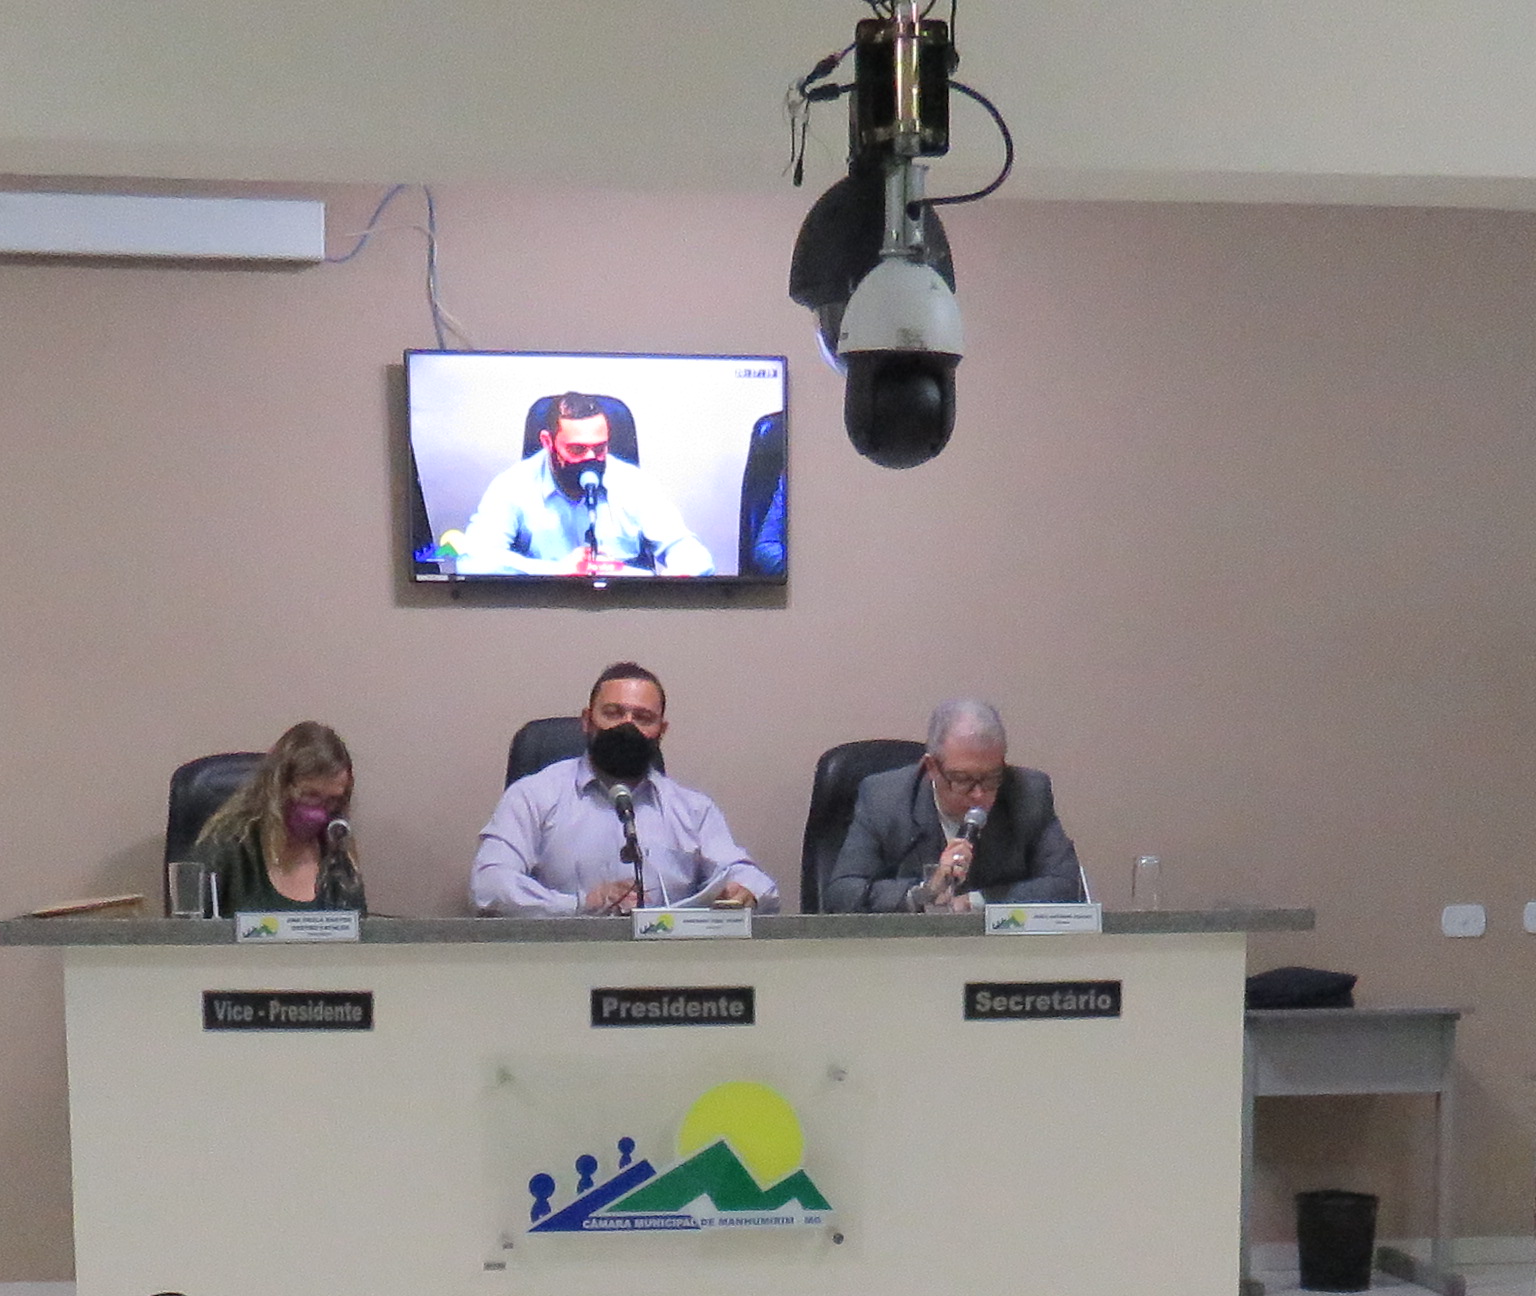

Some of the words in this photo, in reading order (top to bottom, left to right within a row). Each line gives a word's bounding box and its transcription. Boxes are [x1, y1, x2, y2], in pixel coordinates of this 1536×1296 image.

[215, 1000, 254, 1021] Vice
[269, 1000, 363, 1022] Presidente
[602, 996, 745, 1018] Presidente
[975, 990, 1112, 1012] Secretário
[582, 1218, 632, 1229] CÂMARA
[634, 1217, 699, 1229] MUNICIPAL
